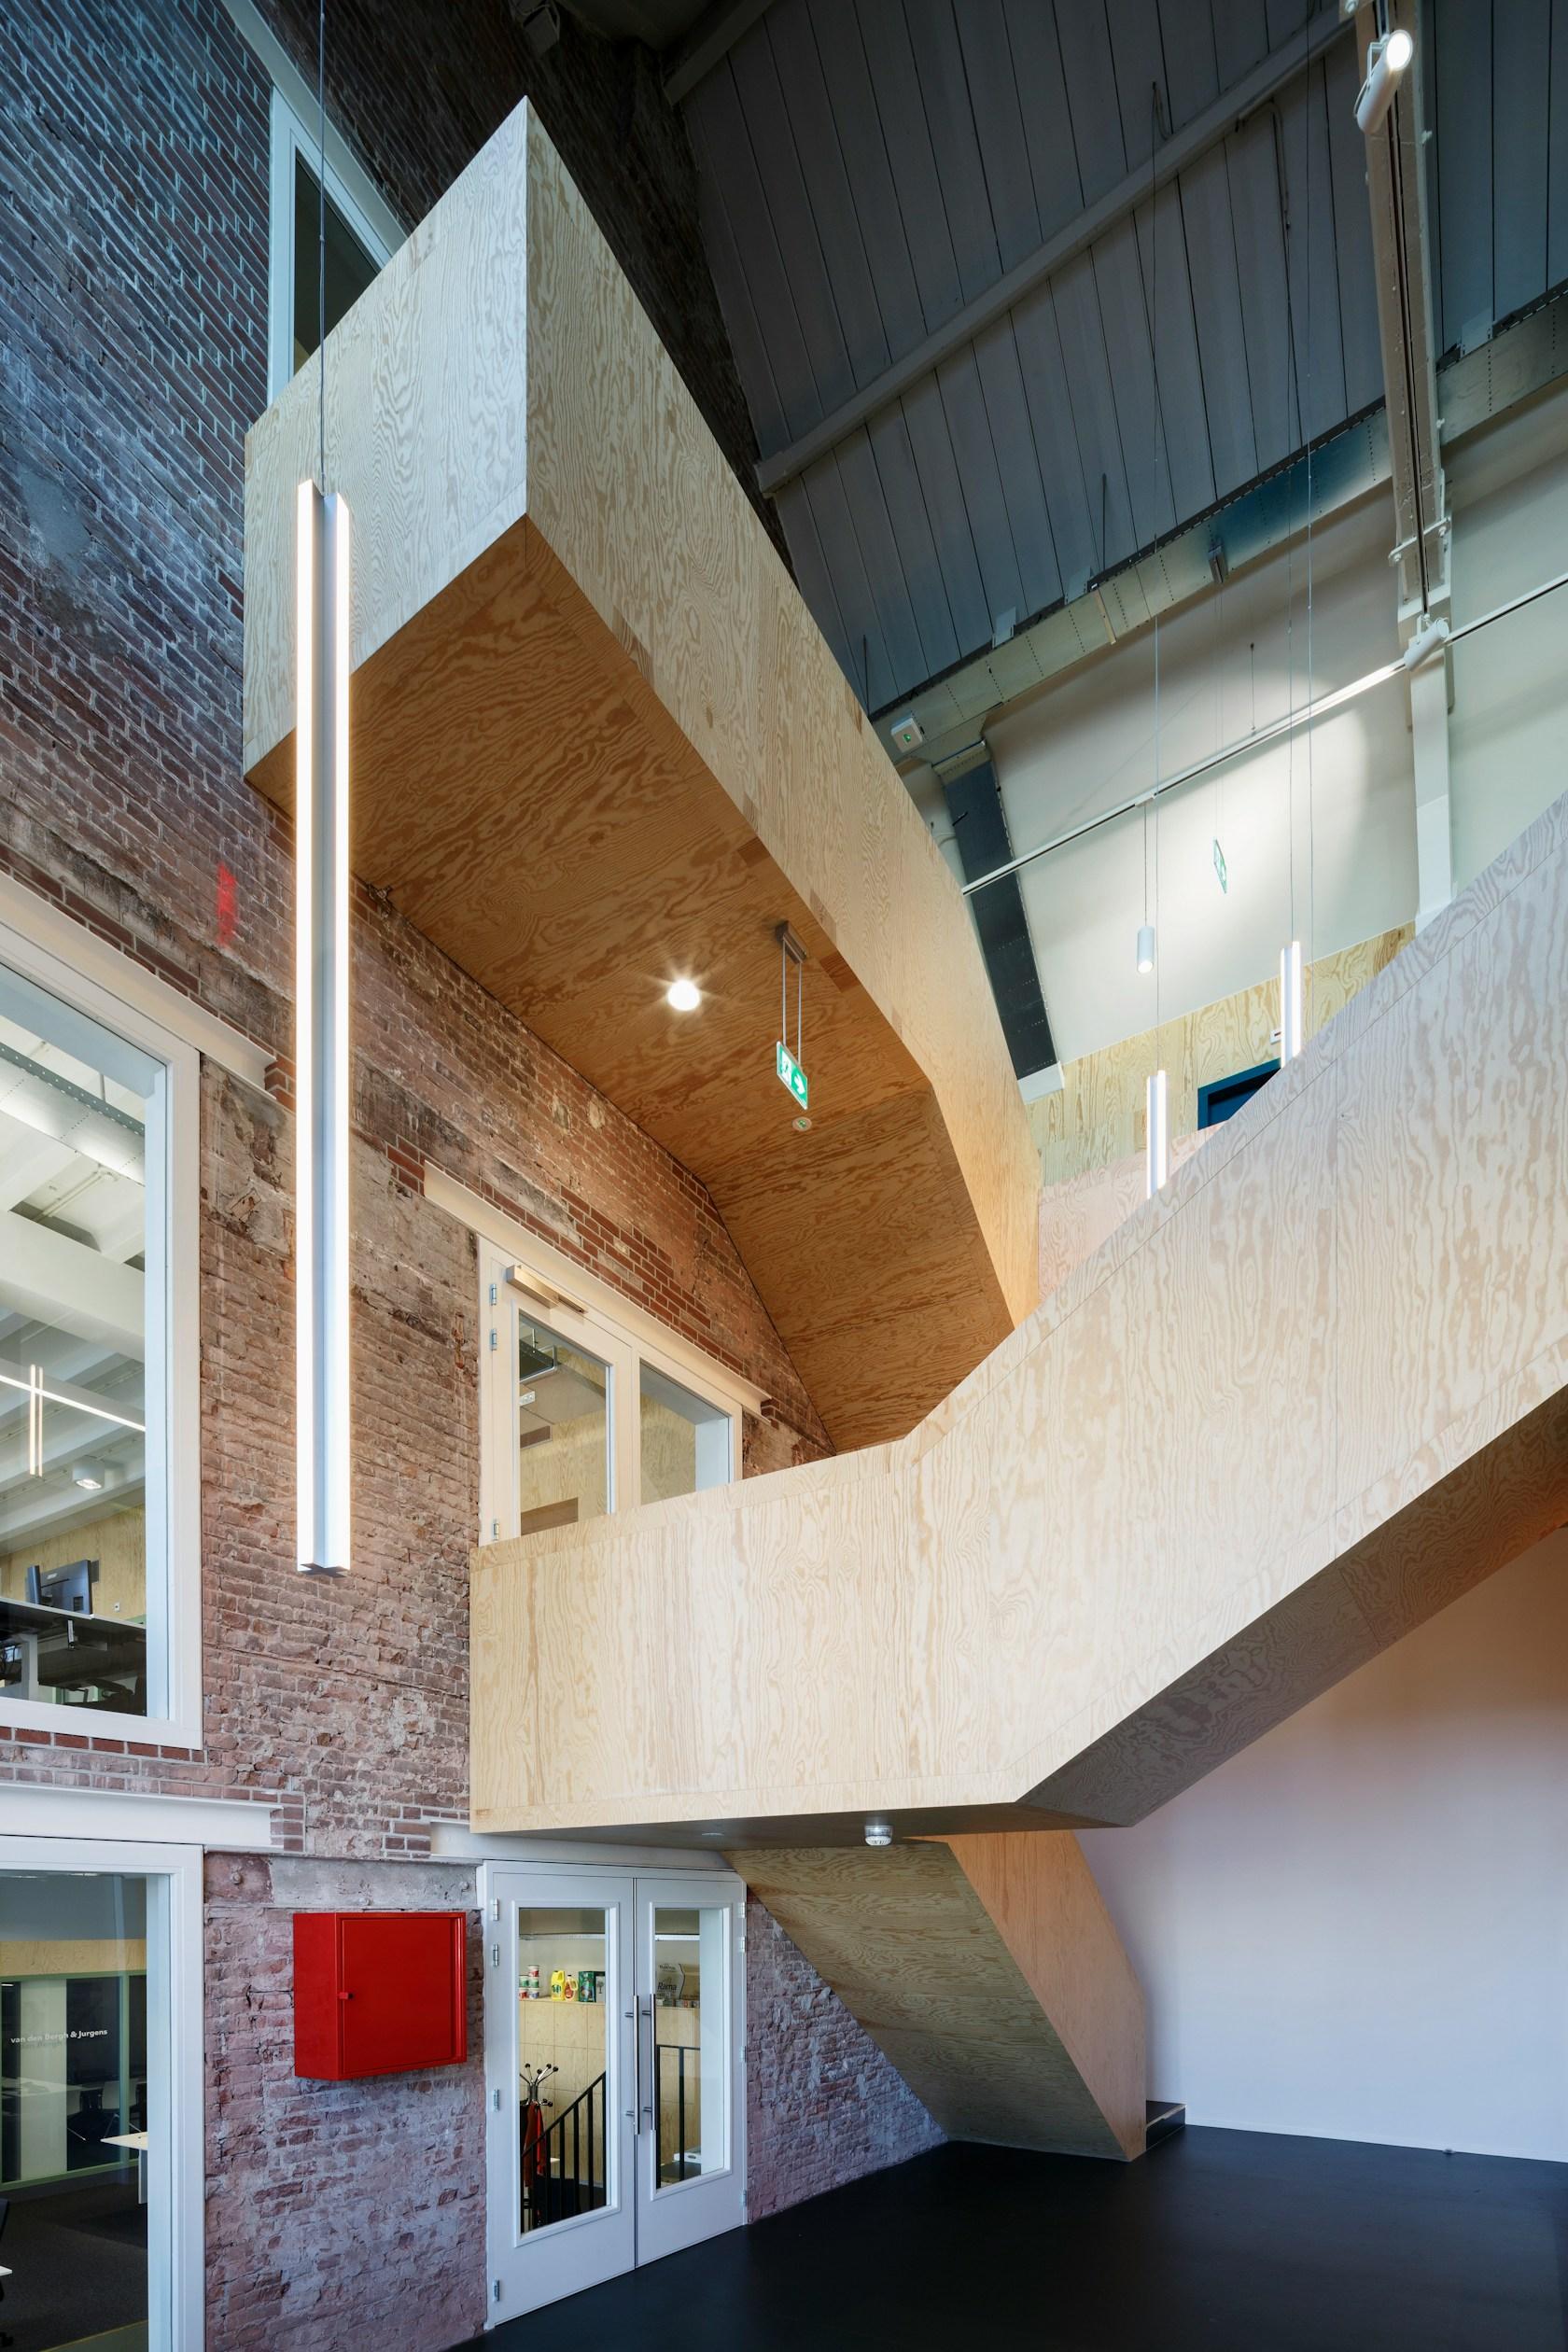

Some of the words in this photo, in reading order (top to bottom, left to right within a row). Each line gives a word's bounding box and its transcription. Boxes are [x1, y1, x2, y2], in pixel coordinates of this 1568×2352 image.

[657, 1981, 677, 1990] Rama
[27, 2034, 43, 2042] den
[44, 2032, 69, 2041] Bergh
[70, 2030, 77, 2038] &
[77, 2029, 108, 2039] Jurgens
